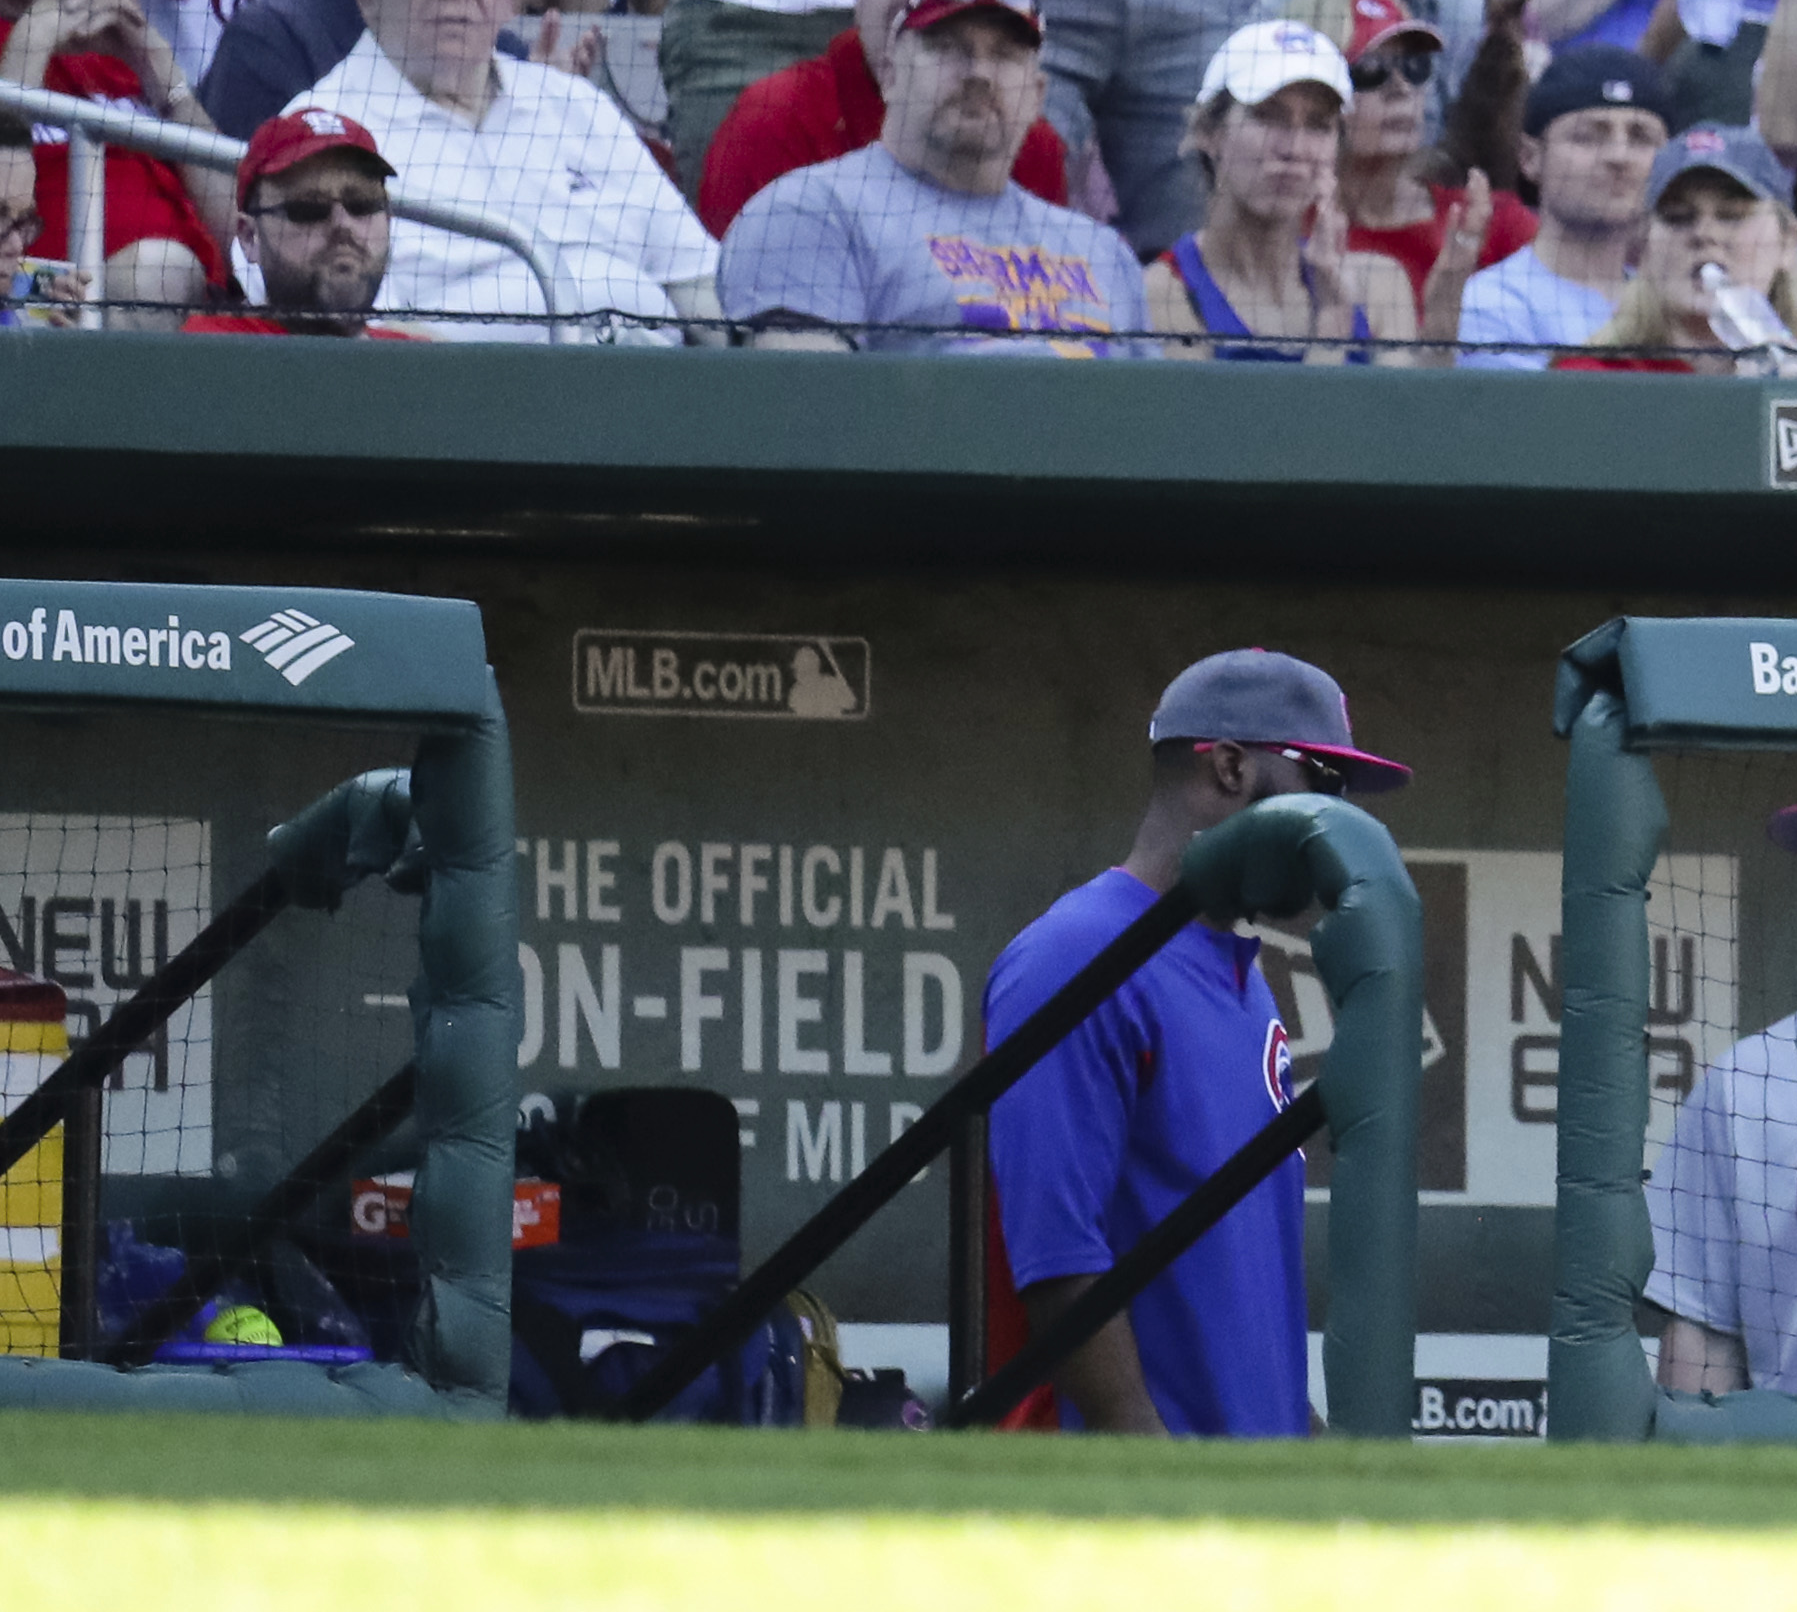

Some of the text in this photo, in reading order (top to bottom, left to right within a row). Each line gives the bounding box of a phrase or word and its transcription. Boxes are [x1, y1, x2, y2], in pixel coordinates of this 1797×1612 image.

[2, 607, 231, 670] of America
[586, 645, 783, 702] MLB.com
[652, 840, 956, 930] OFFICIAL
[1411, 1386, 1534, 1431] B.com
